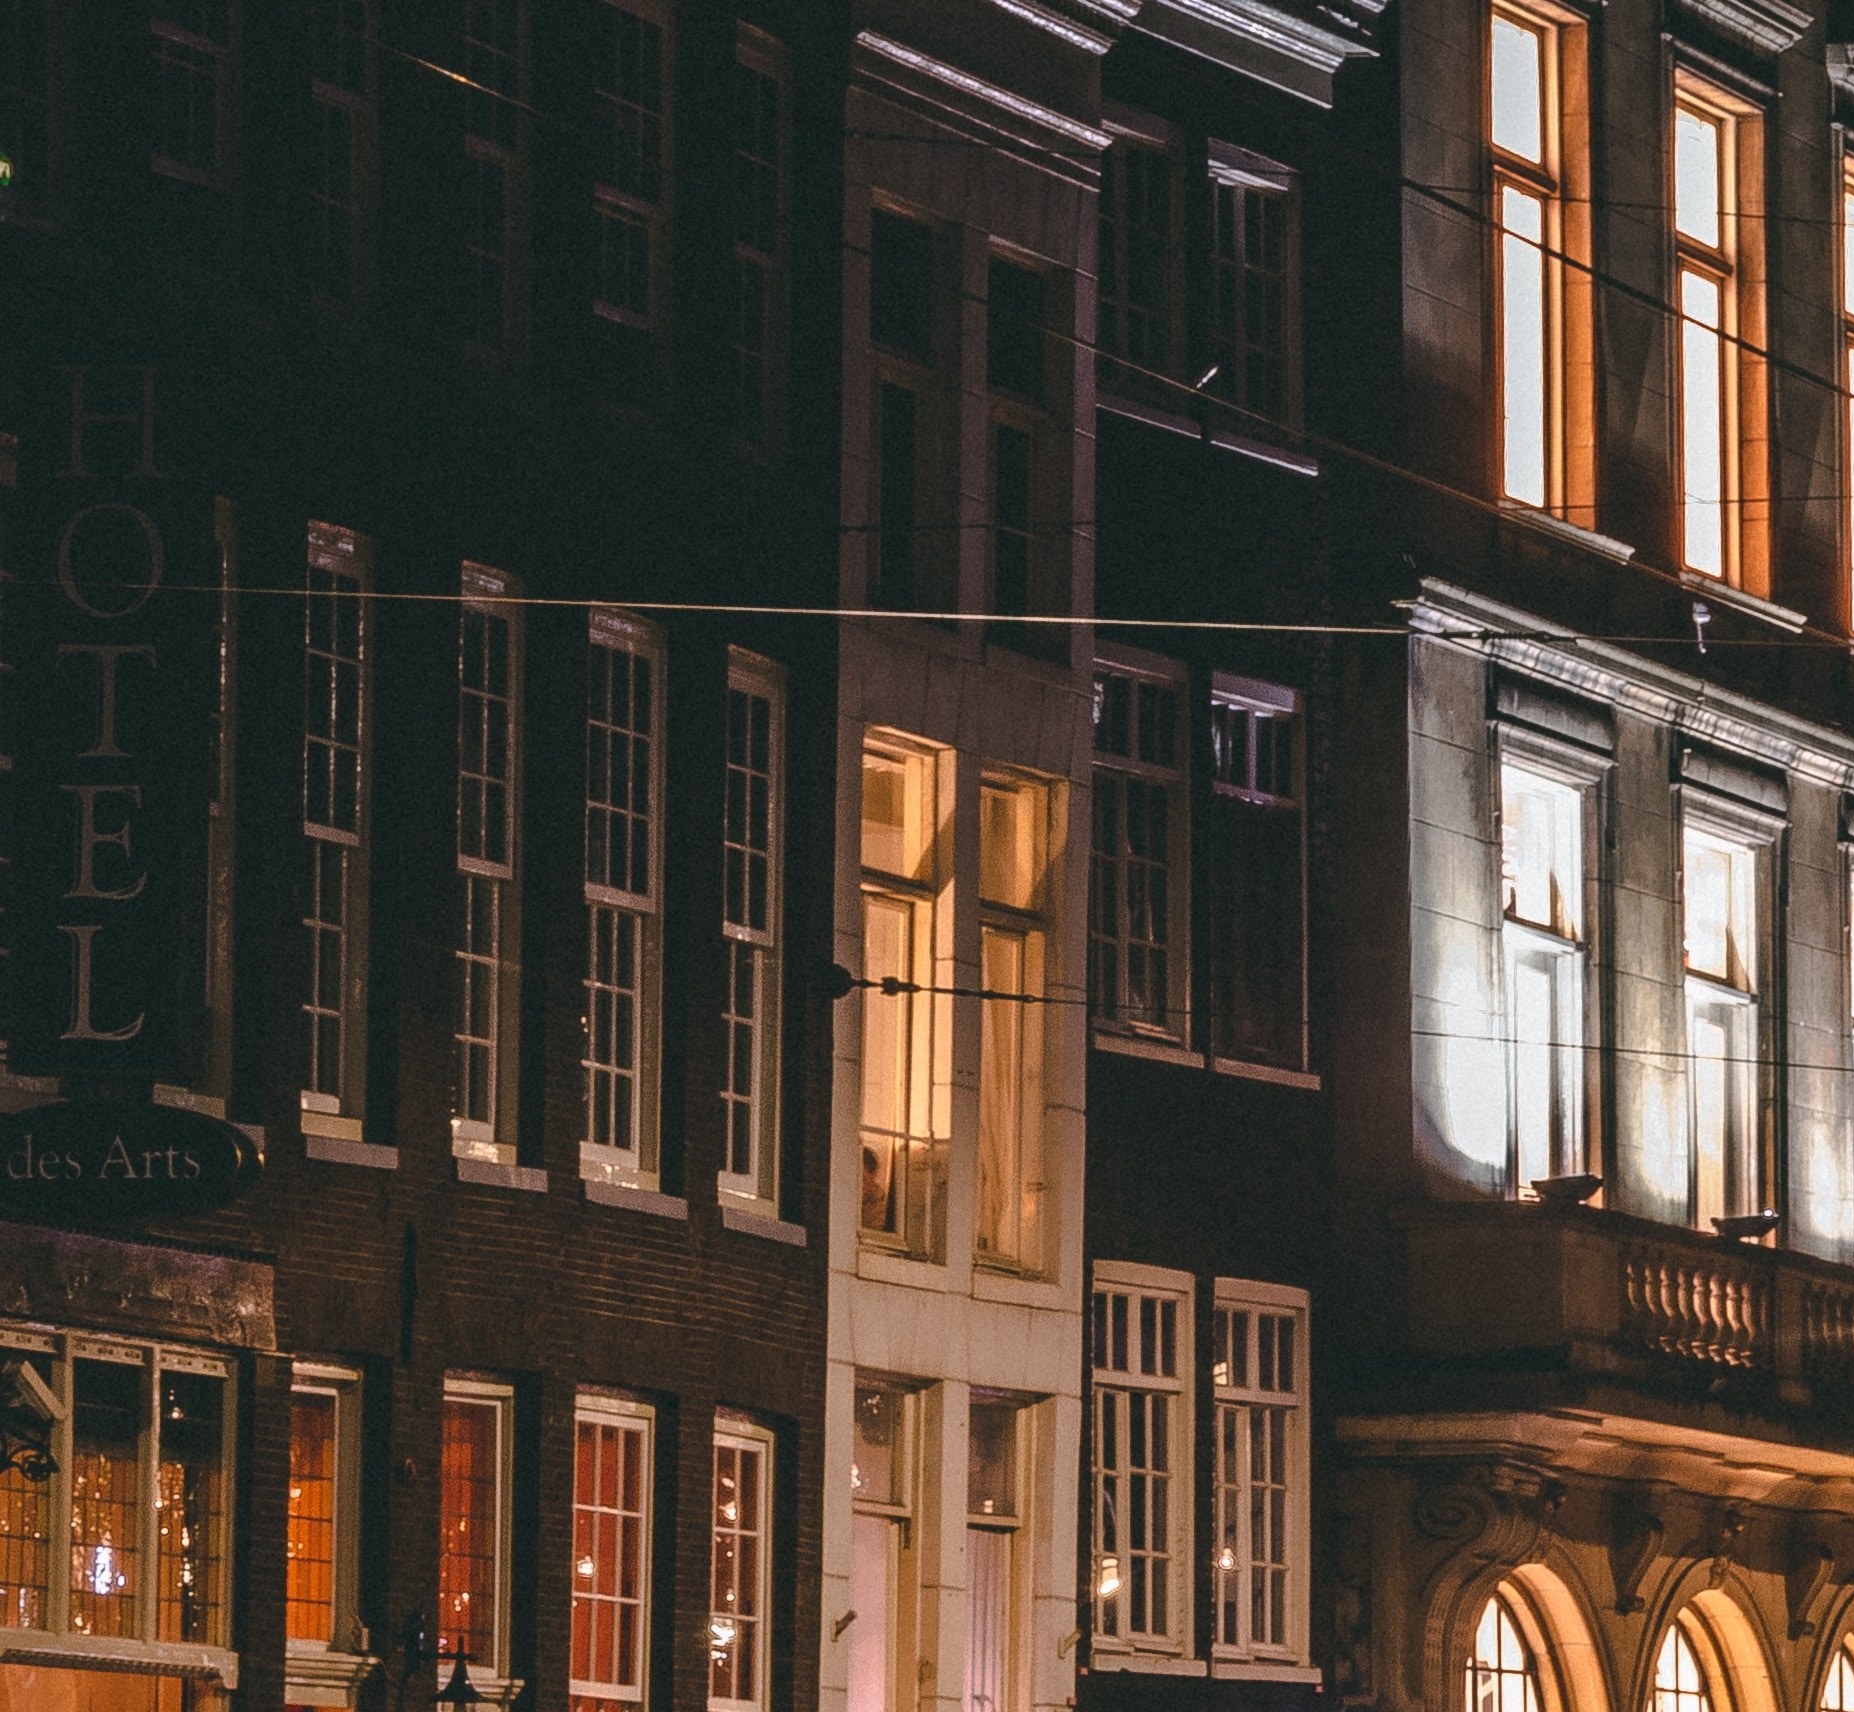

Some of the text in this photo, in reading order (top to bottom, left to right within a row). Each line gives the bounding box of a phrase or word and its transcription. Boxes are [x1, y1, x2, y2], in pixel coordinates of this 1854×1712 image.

[53, 364, 168, 1043] HOTEL
[7, 1134, 202, 1182] des Arts
